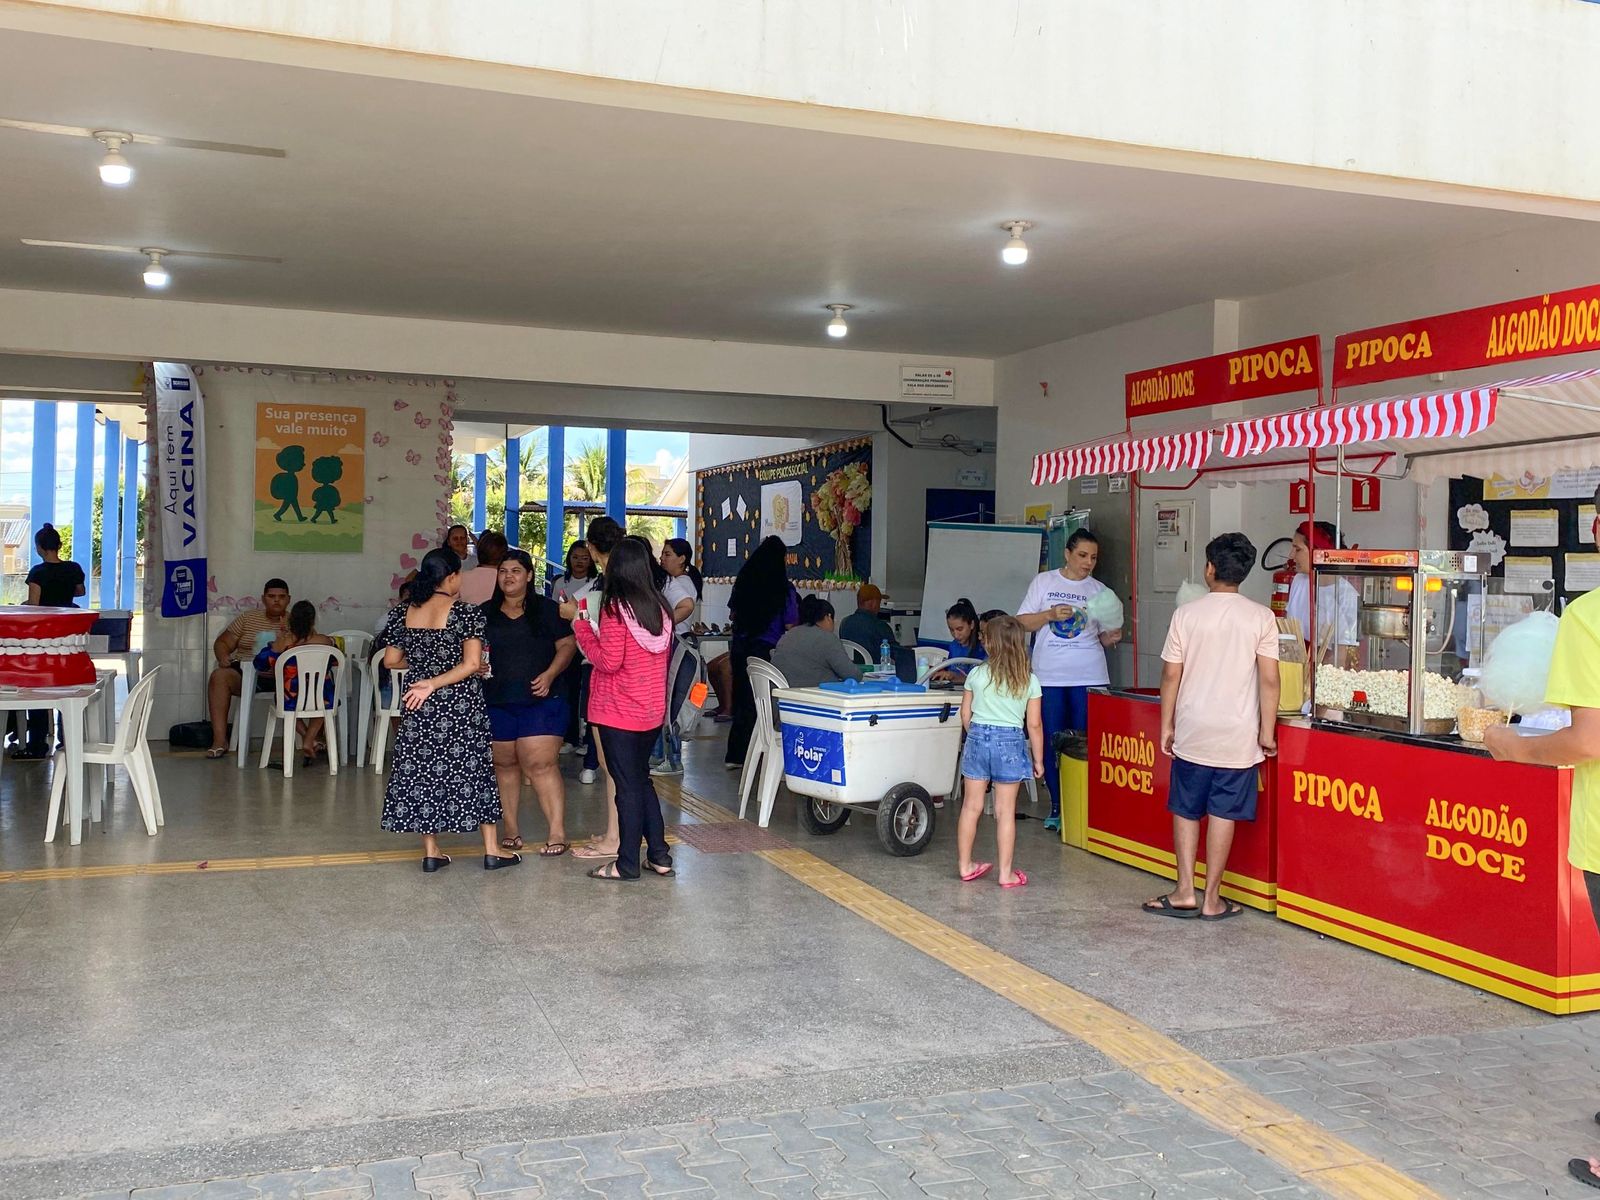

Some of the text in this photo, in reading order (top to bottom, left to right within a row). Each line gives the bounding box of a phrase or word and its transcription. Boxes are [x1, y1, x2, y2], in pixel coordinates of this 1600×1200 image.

[1346, 294, 1600, 369] PIPOCA ALGODÃO DOC
[1131, 345, 1313, 406] ALGODÃO DOCE PIPOCA
[265, 407, 357, 425] Sua presença
[275, 423, 347, 436] vale muito
[164, 425, 179, 515] Aqui tem
[180, 400, 196, 547] VACINA
[760, 468, 776, 481] EQUIPE
[797, 745, 823, 762] Polar
[1100, 731, 1155, 768] ALGODÃO
[1100, 761, 1154, 795] DOCE
[1293, 770, 1384, 822] PIPOCA
[1425, 798, 1528, 847] ALGODÃO
[1426, 834, 1526, 883] DOCE
